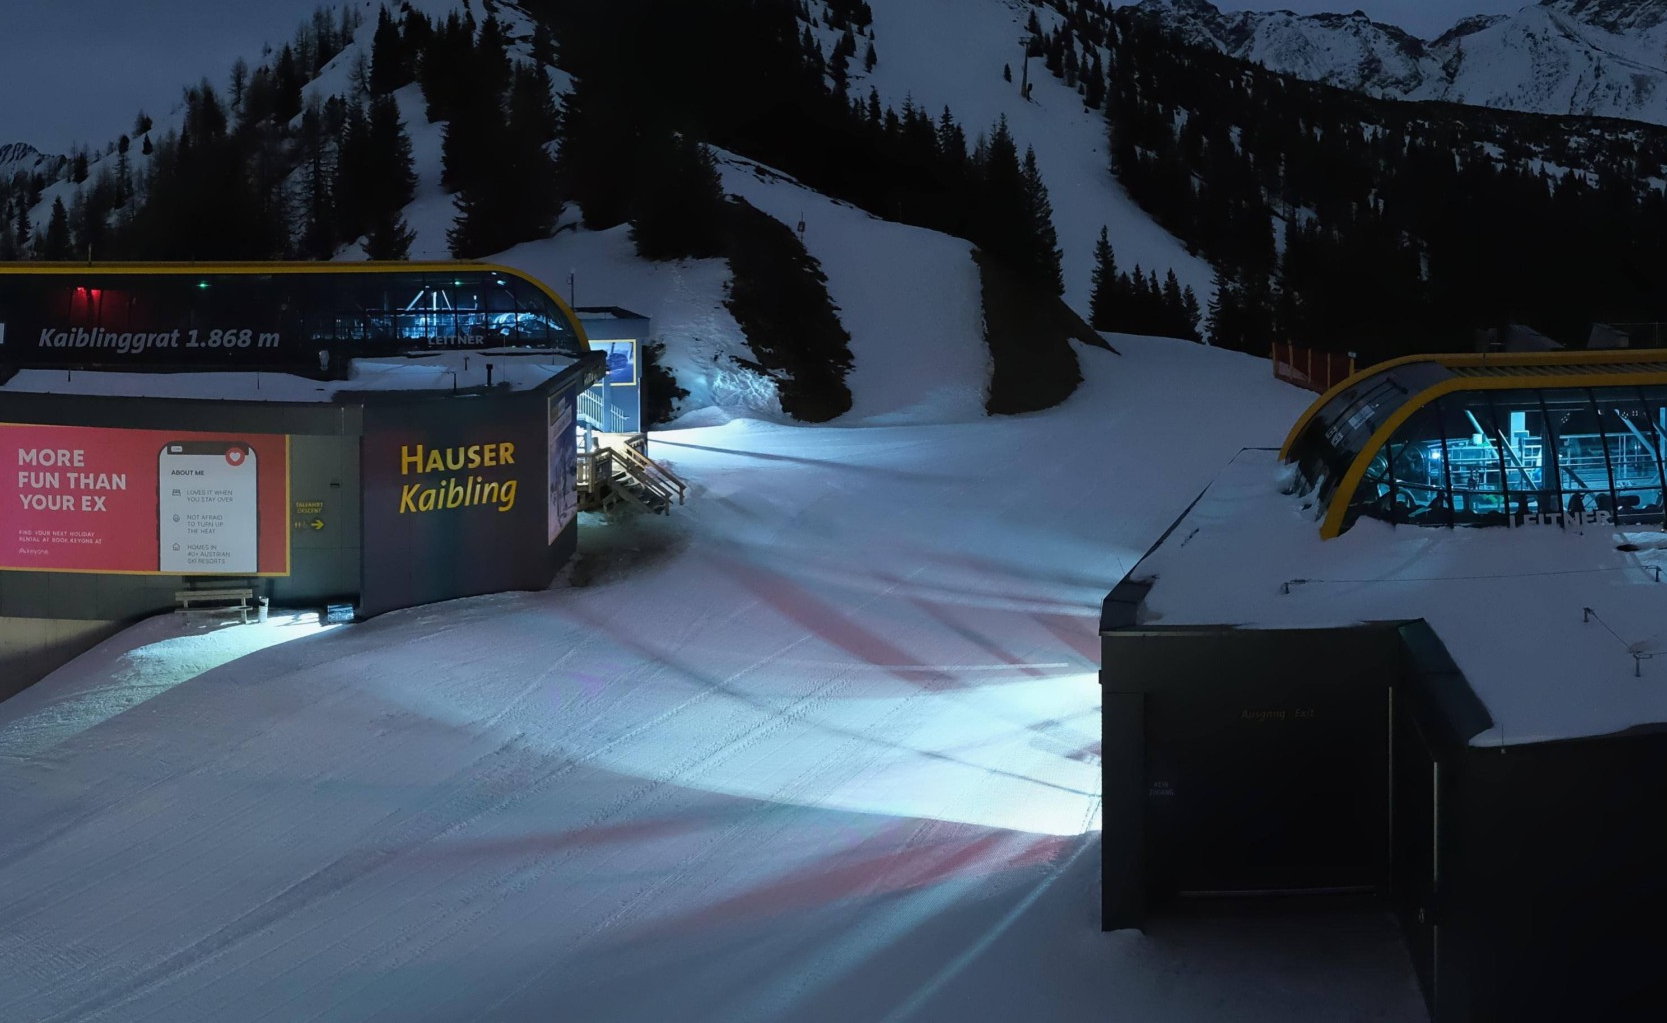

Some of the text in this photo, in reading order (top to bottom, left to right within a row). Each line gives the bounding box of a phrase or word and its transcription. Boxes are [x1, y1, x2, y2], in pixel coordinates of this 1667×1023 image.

[38, 327, 280, 354] Kaiblinggrat 1.868 m
[428, 335, 484, 345] LEITNER
[18, 448, 85, 467] MORE
[400, 441, 516, 475] HAUSER
[18, 471, 127, 490] FUN THAN
[20, 494, 107, 512] YOUR EX
[399, 475, 518, 514] Kaibling
[1509, 510, 1612, 527] LEITNER
[1295, 708, 1315, 718] Exit
